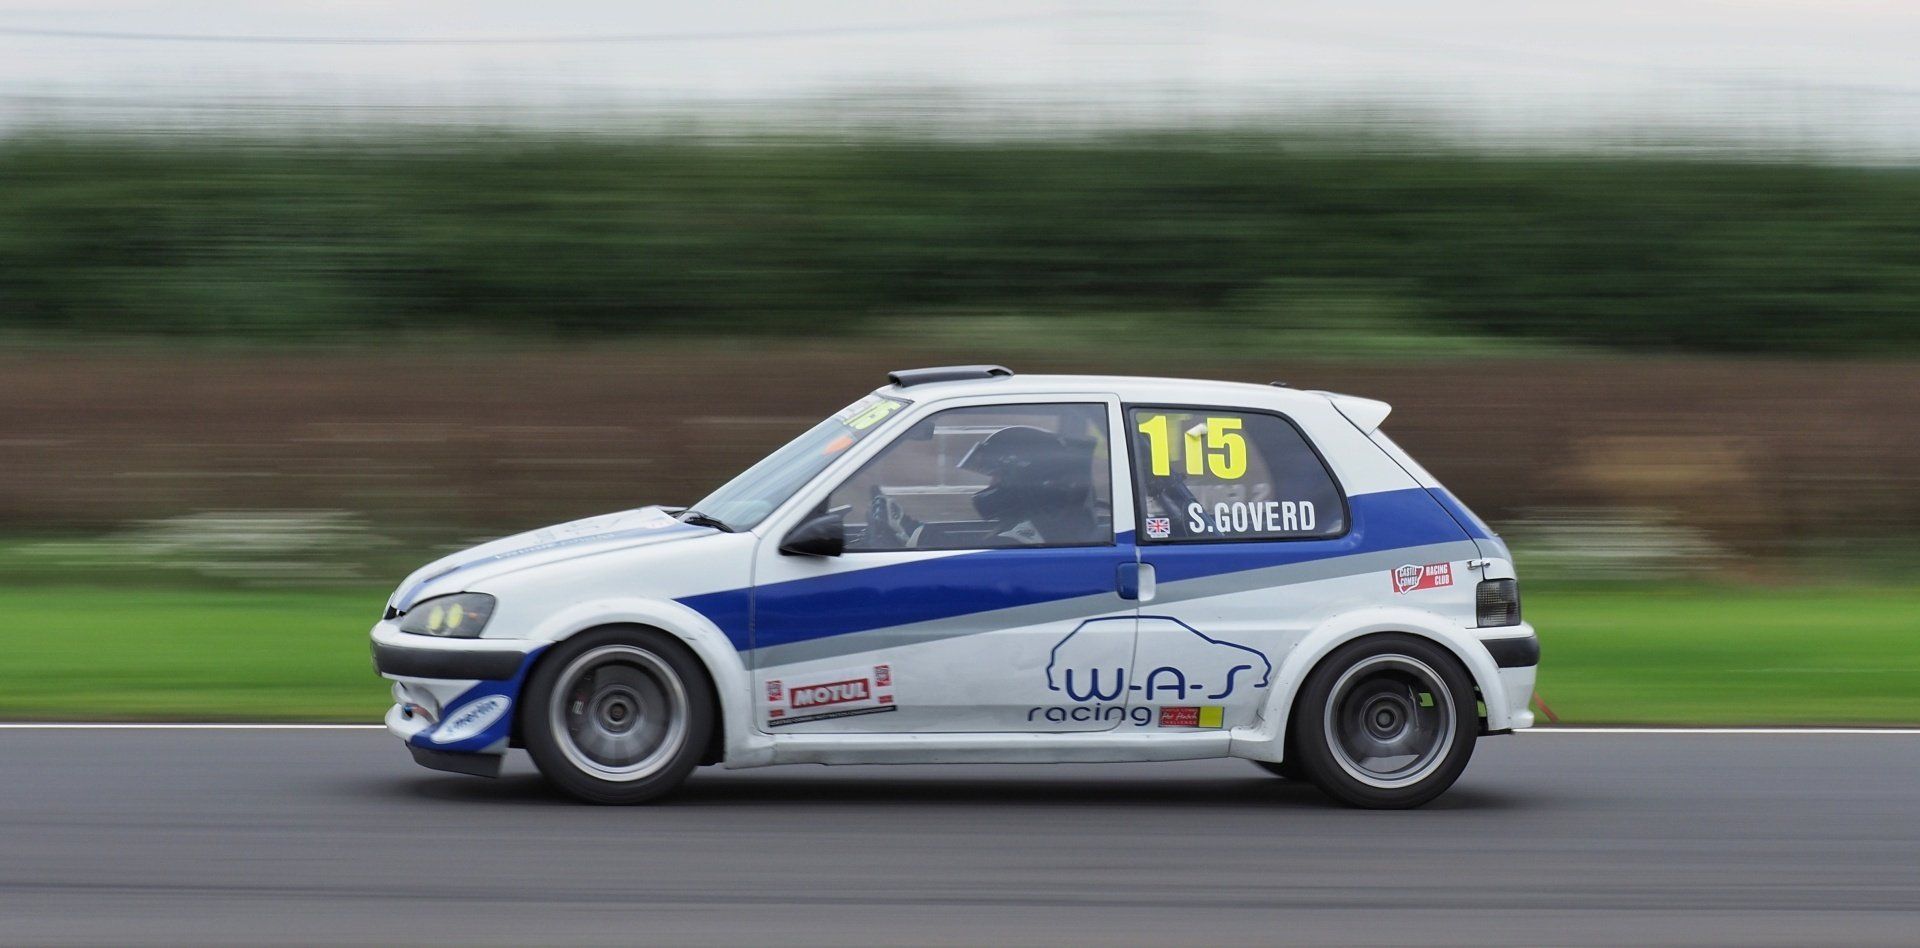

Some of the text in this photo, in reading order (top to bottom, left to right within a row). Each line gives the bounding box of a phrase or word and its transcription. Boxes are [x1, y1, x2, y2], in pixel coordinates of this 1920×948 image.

[1138, 415, 1247, 480] 115
[1187, 501, 1316, 534] S.GOVERD
[1425, 564, 1448, 576] RACING
[1435, 575, 1449, 586] CLUB
[794, 681, 868, 707] MOTUL
[1027, 703, 1153, 727] racing
